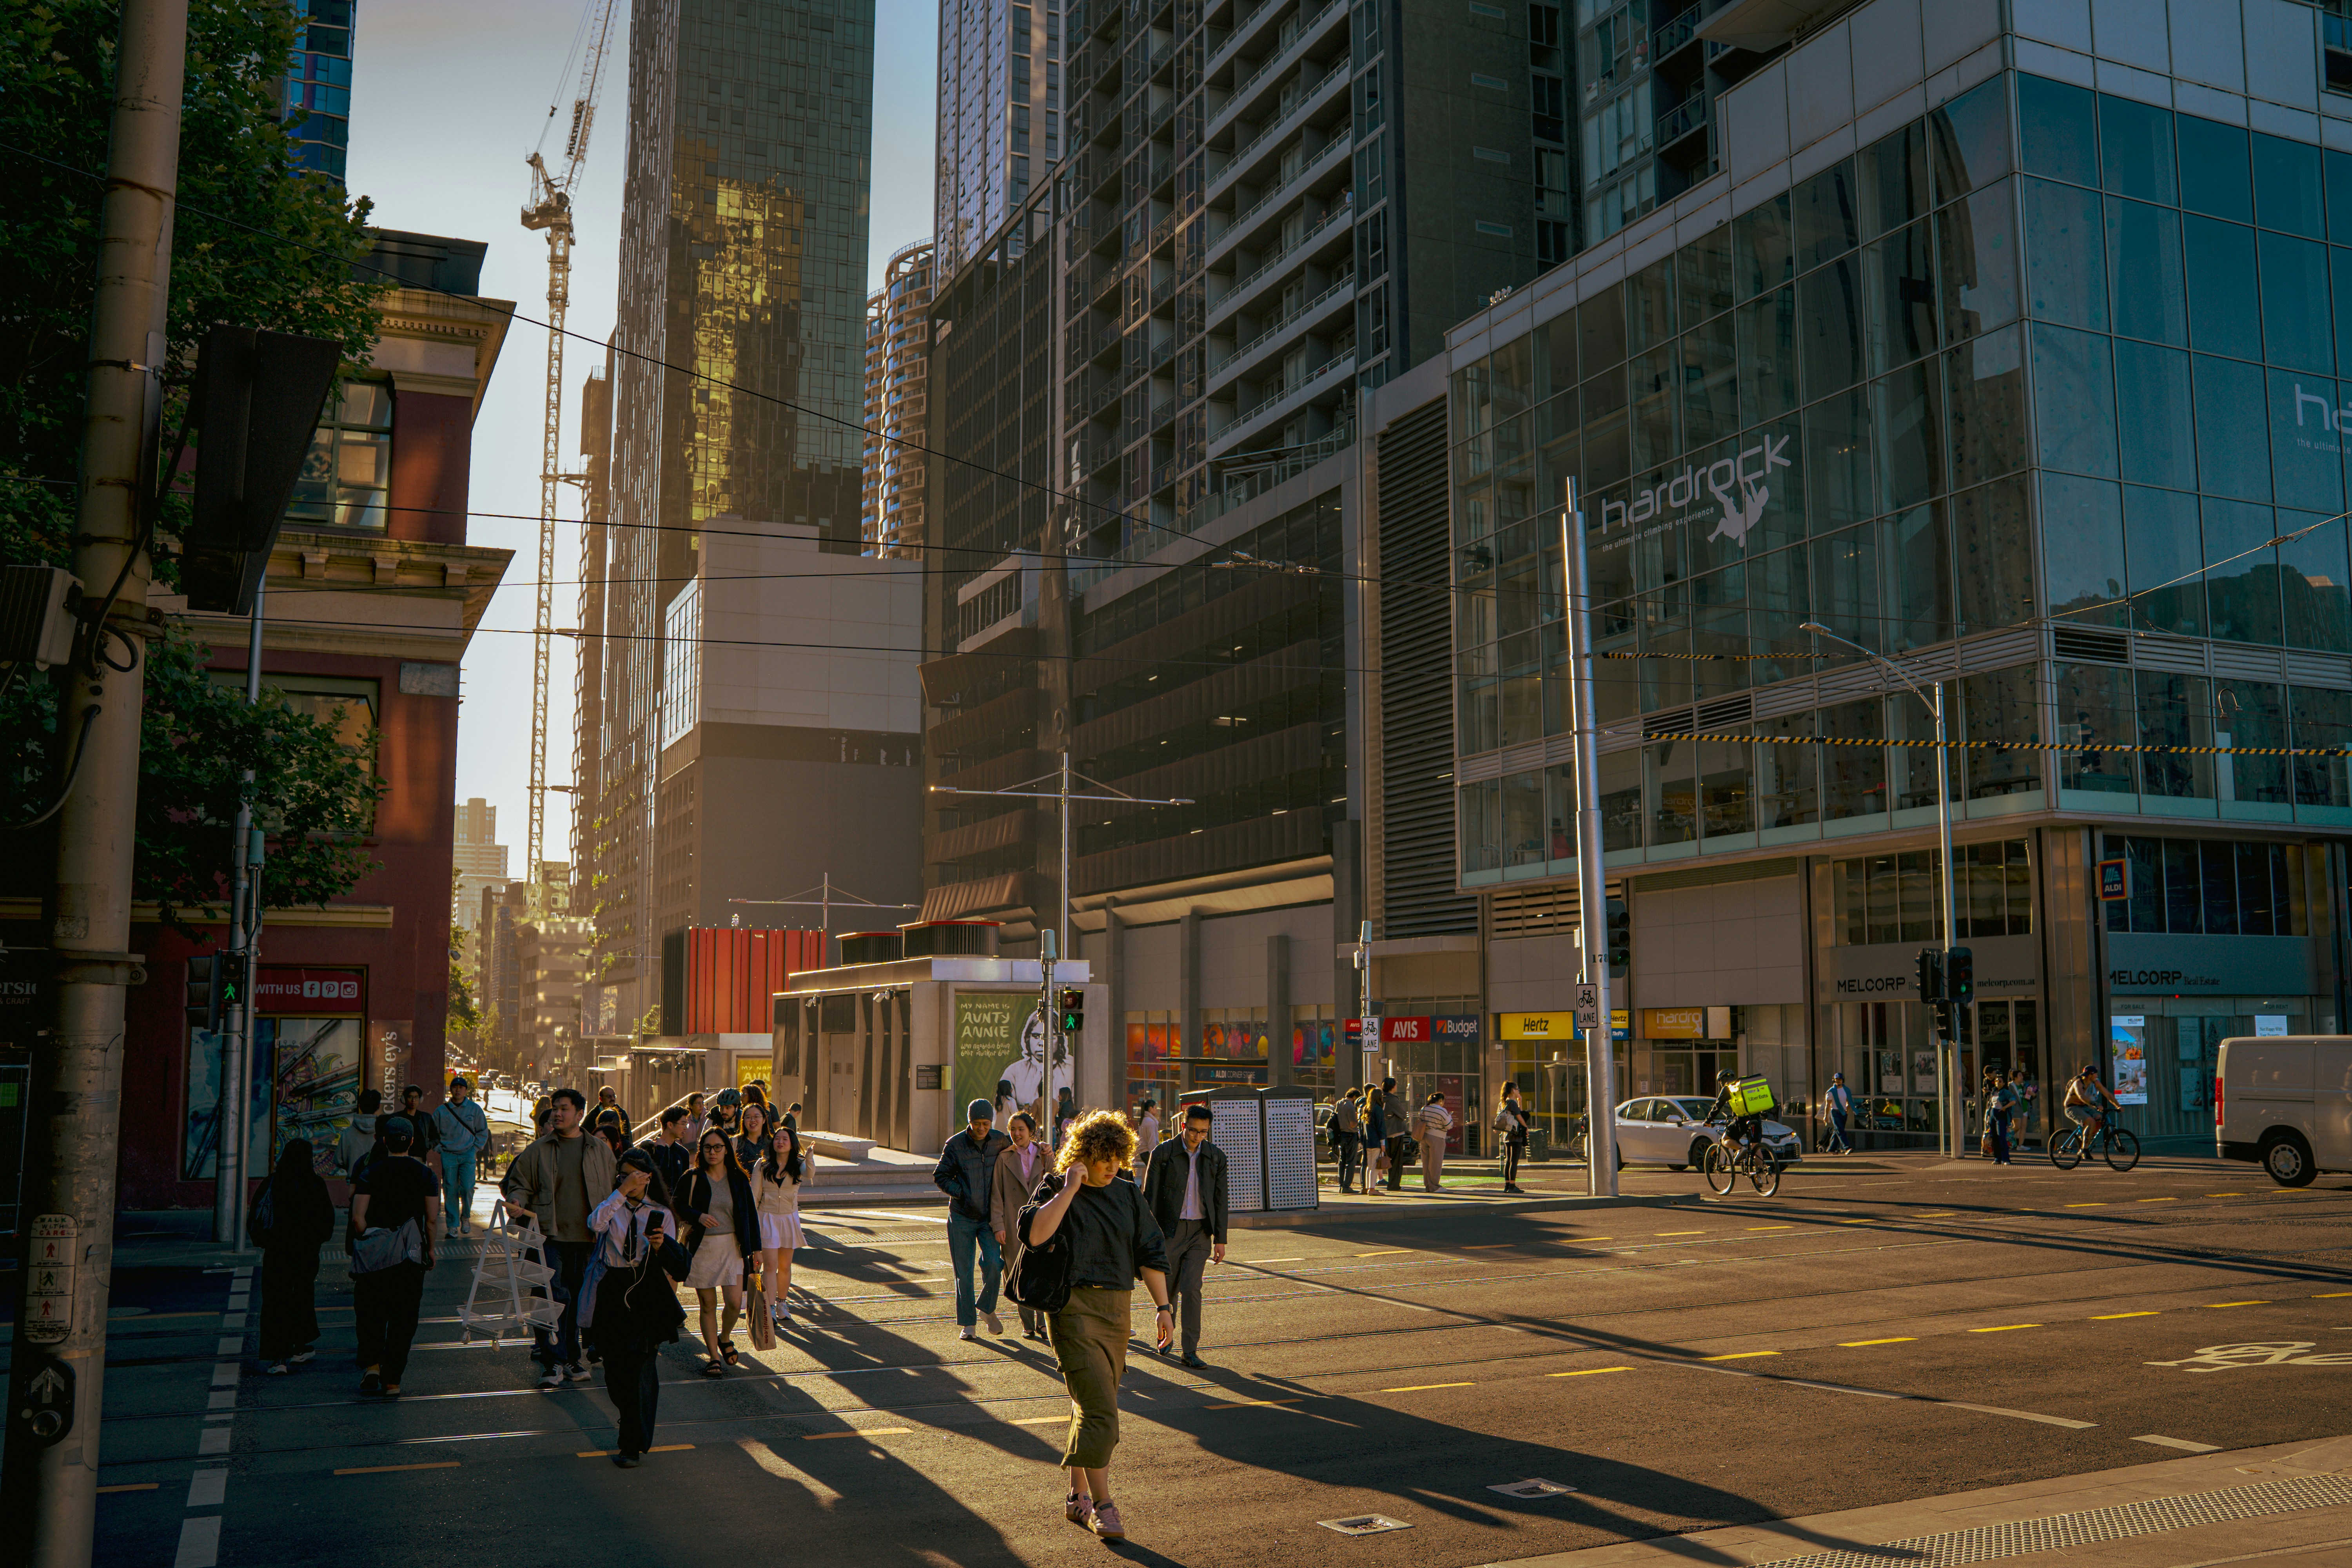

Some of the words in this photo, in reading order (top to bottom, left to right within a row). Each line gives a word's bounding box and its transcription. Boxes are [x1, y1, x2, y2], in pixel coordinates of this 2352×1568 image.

[2297, 438, 2311, 448] the
[1602, 434, 1791, 534] hardrock
[1602, 544, 1612, 552] the
[1615, 533, 1642, 548] ultimate
[1644, 521, 1673, 537] climbing
[1676, 507, 1714, 527] experience
[2104, 883, 2122, 893] ALDI
[1592, 954, 1608, 963] 178
[2110, 971, 2182, 985] MELCORP
[2184, 976, 2198, 985] Real
[2200, 976, 2220, 985] Estate
[255, 984, 283, 994] WITH
[286, 984, 300, 995] US
[1838, 977, 1906, 993] MELCORP
[961, 1011, 1010, 1024] AUNTY
[1579, 1013, 1595, 1023] LANE
[1392, 1020, 1418, 1038] AVIS
[1447, 1020, 1477, 1037] Budget
[1523, 1018, 1549, 1031] Hertz
[961, 1025, 1009, 1038] ANNIE
[1364, 1040, 1377, 1048] LANE
[742, 1072, 771, 1082] AUN
